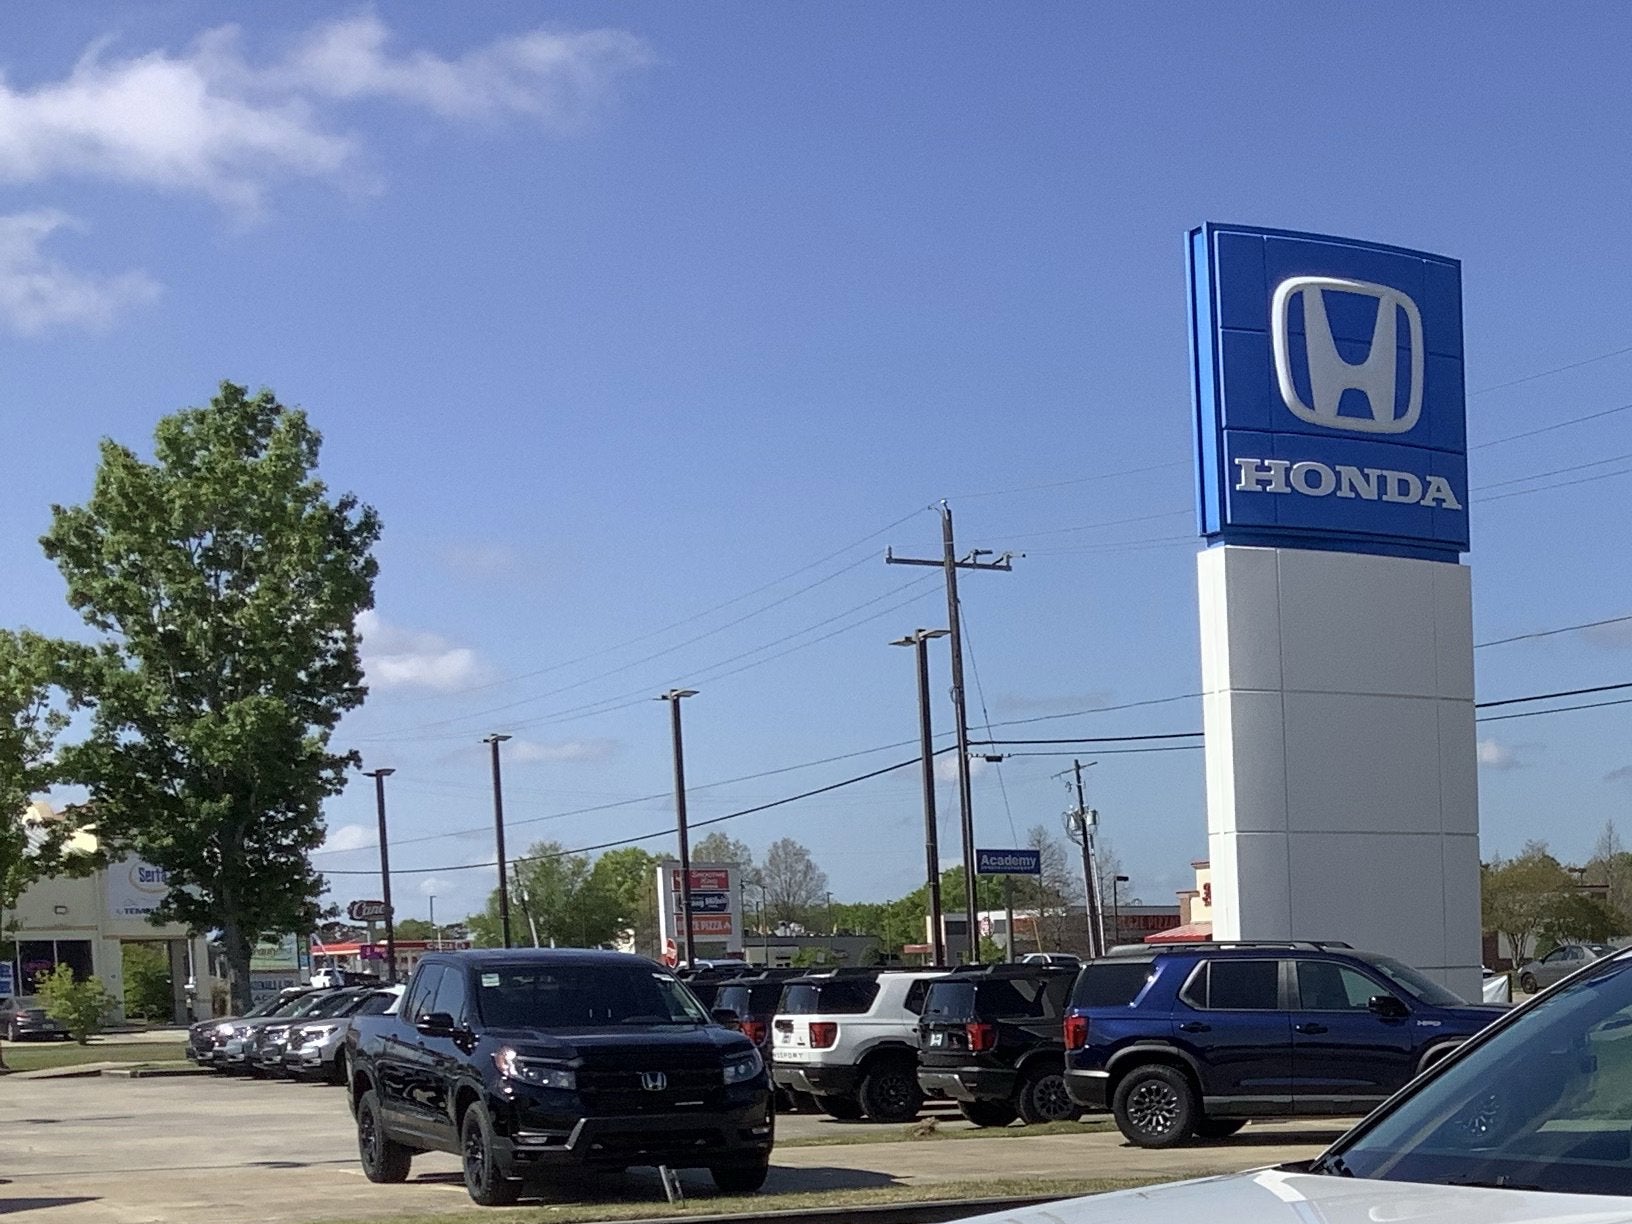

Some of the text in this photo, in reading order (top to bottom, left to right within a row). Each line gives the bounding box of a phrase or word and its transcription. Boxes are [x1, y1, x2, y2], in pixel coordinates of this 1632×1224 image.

[1234, 457, 1463, 511] HONDA
[981, 854, 1037, 869] Academy
[138, 867, 168, 882] Serta
